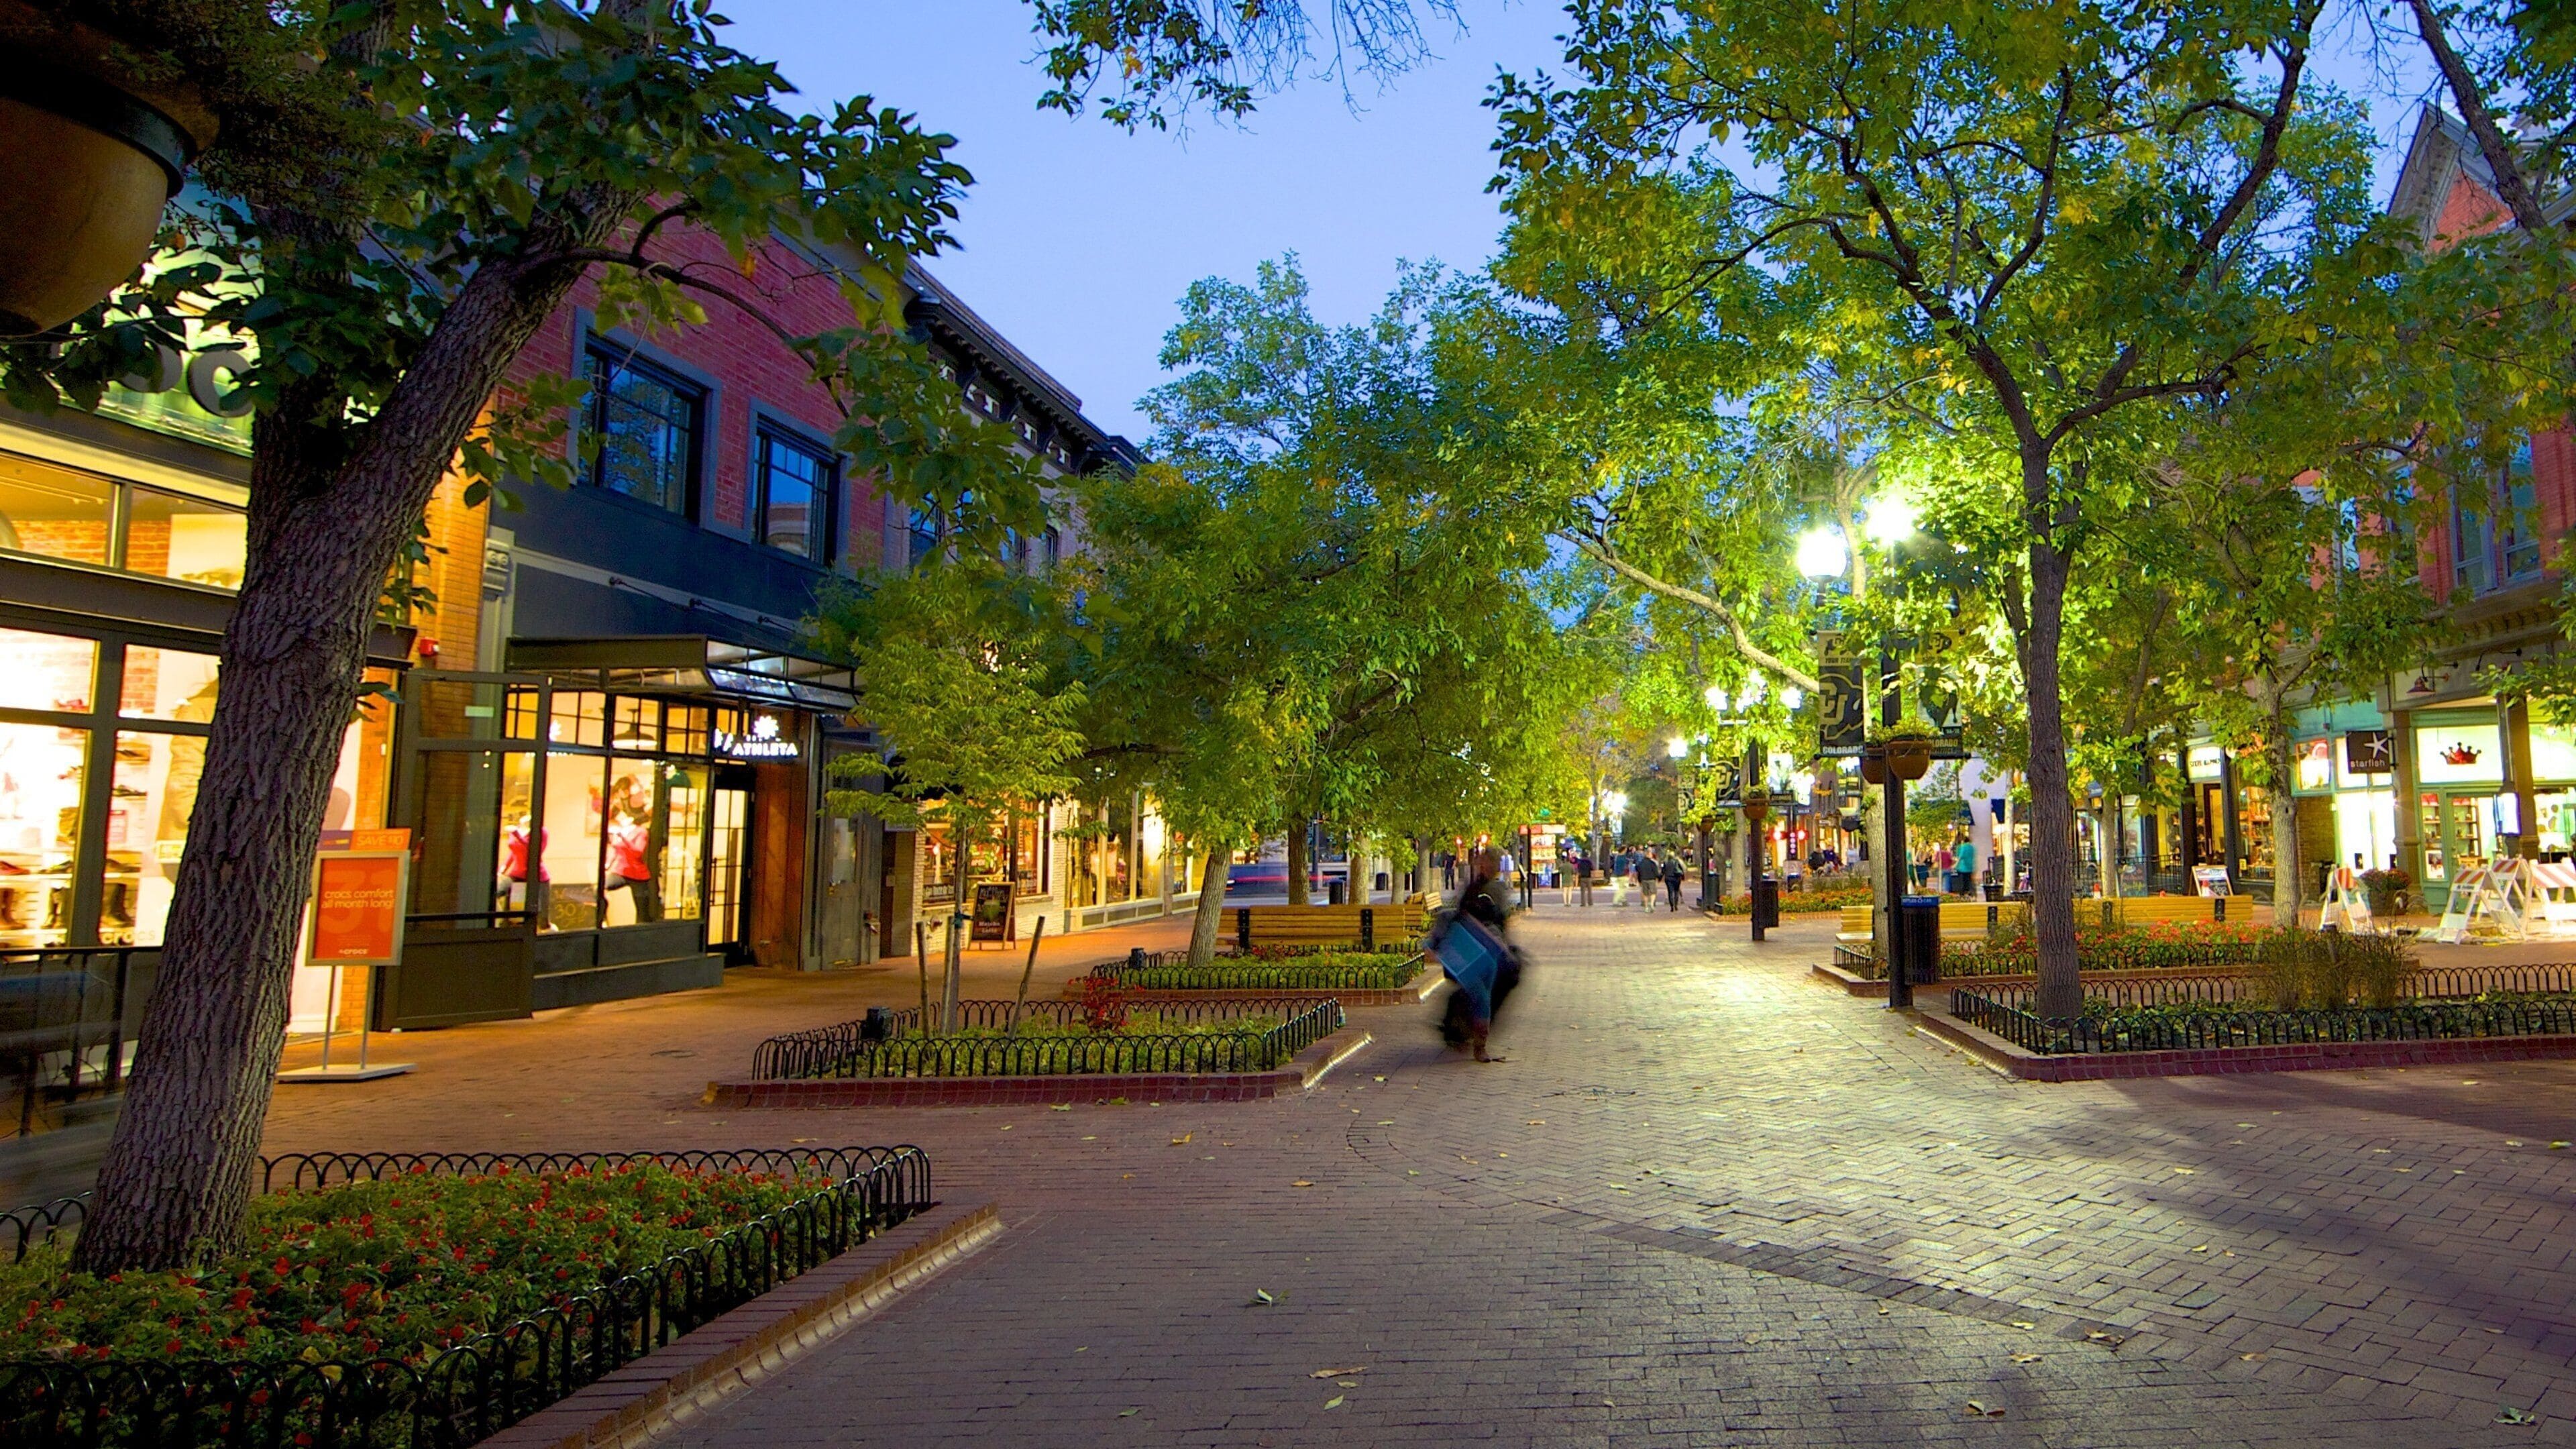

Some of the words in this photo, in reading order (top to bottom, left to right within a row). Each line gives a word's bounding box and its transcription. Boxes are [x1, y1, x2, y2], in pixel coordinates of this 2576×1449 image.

[732, 742, 798, 756] ATHLETA
[1822, 745, 1864, 754] COLORADO
[2351, 759, 2385, 767] starfish
[356, 835, 385, 846] SAVE
[324, 890, 352, 899] crocs
[354, 888, 394, 898] comfort
[321, 900, 333, 908] all
[334, 899, 369, 908] month
[101, 930, 156, 945] crocs
